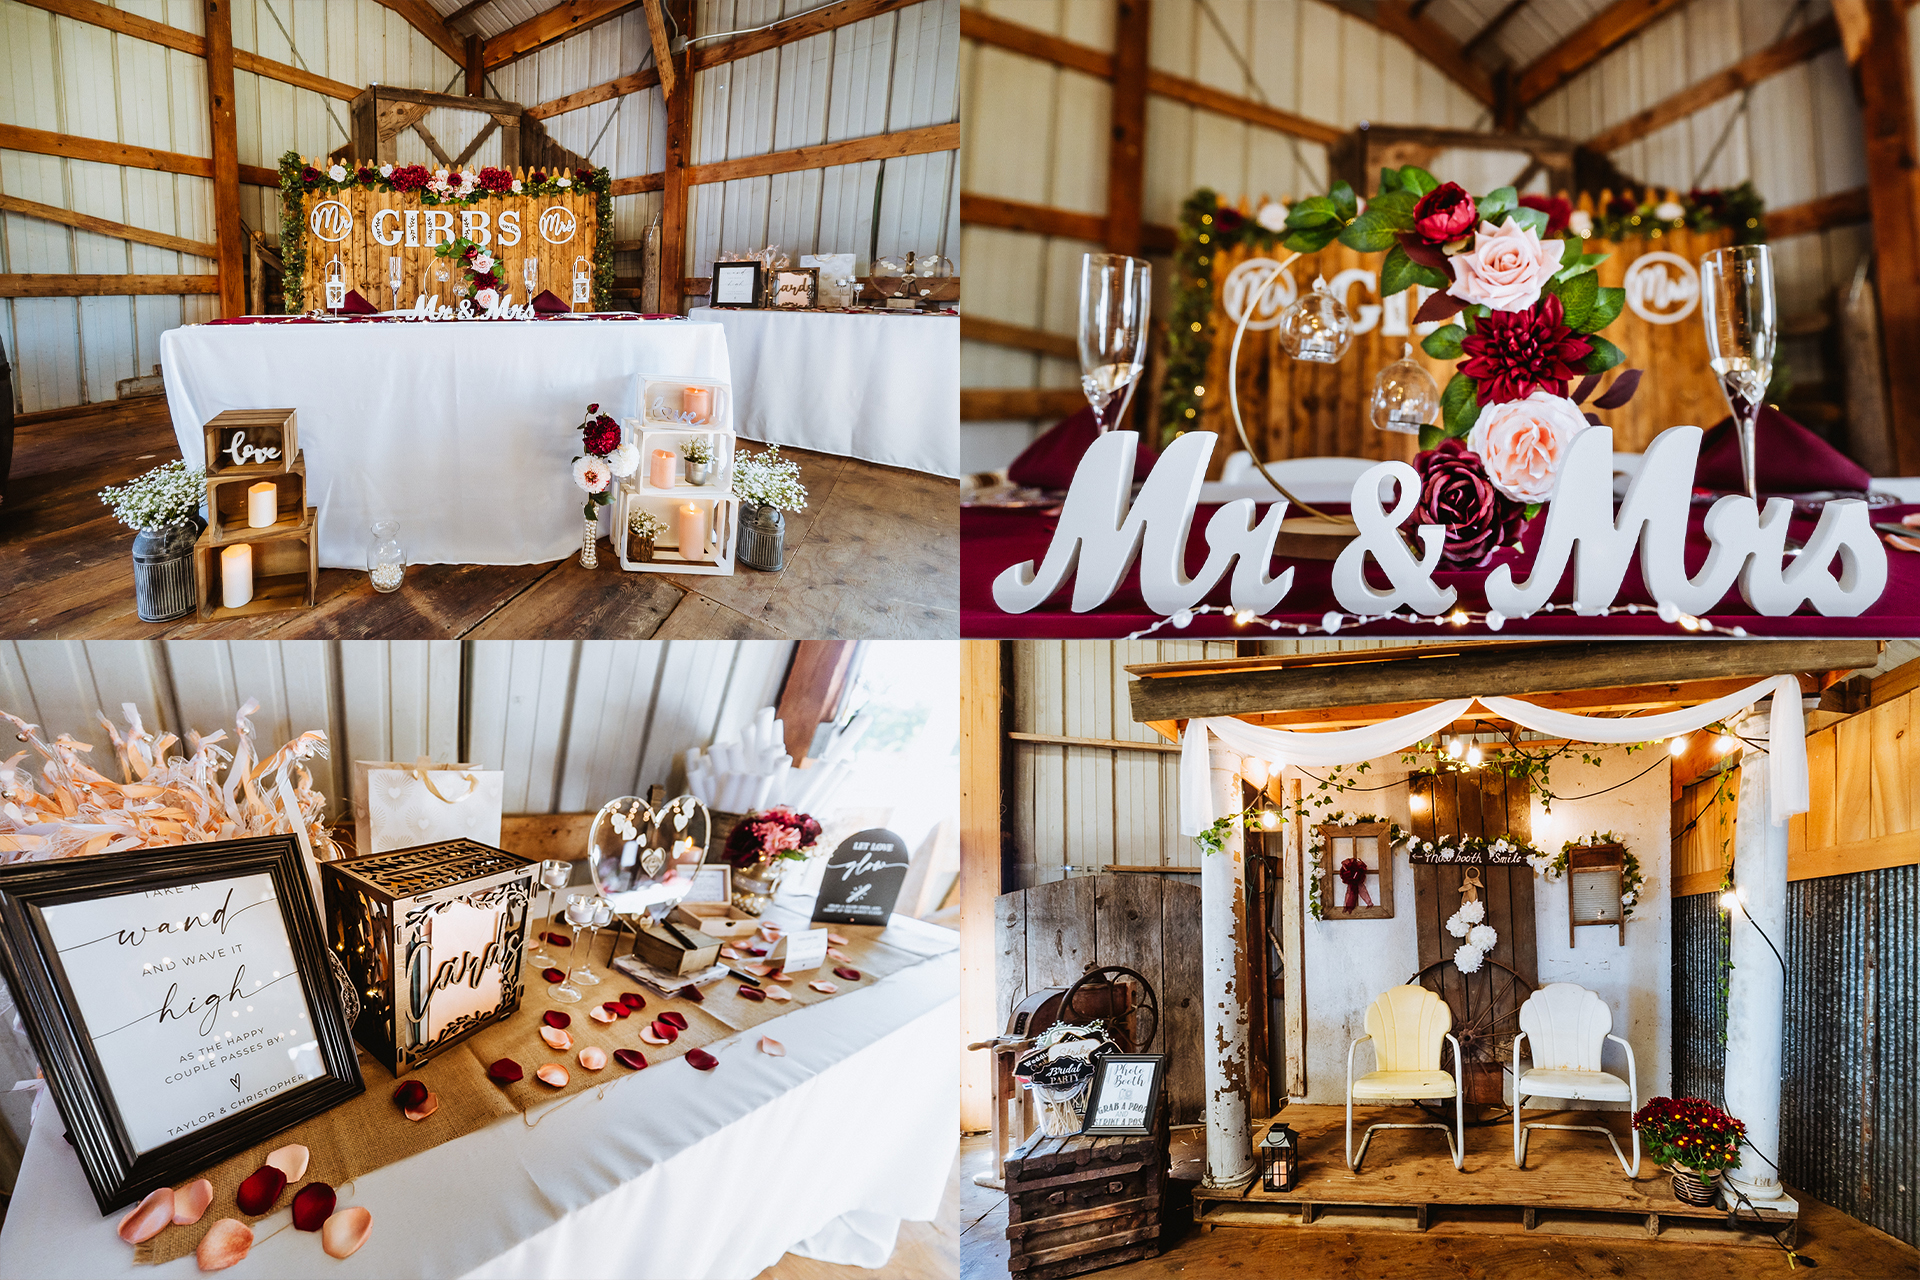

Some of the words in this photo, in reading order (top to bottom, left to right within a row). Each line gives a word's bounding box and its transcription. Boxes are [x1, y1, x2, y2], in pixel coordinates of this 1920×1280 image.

[314, 205, 352, 235] Mr
[371, 209, 522, 248] GIBBS
[541, 212, 576, 236] Mrs
[405, 294, 453, 320] Mr
[457, 299, 474, 319] &
[480, 294, 535, 320] Mrs
[651, 396, 705, 426] love
[222, 431, 282, 466] love
[992, 430, 1295, 616] Mr
[1332, 461, 1458, 616] &
[1485, 426, 1889, 618] Mrs
[852, 842, 870, 851] LET
[870, 843, 894, 852] LOVE
[1493, 853, 1521, 863] Smile
[141, 960, 176, 977] AND
[182, 948, 226, 967] WAVE
[231, 943, 243, 955] IT
[406, 912, 524, 1023] Cards
[179, 1052, 195, 1064] AS
[199, 1042, 223, 1056] THE
[227, 1027, 265, 1046] HAPPY
[1060, 1045, 1091, 1056] Strike
[164, 1059, 217, 1085] COUPLE
[221, 1042, 264, 1064] PASSES
[1045, 1063, 1083, 1077] Bridal
[1114, 1063, 1144, 1076] Photo
[1050, 1074, 1079, 1085] PARTY
[1114, 1074, 1146, 1088] Booth
[167, 1111, 216, 1137] TAYLOR
[219, 1106, 228, 1115] &
[230, 1073, 305, 1110] CHRISTOPHER
[1097, 1103, 1120, 1115] GRAB
[1121, 1102, 1126, 1110] A
